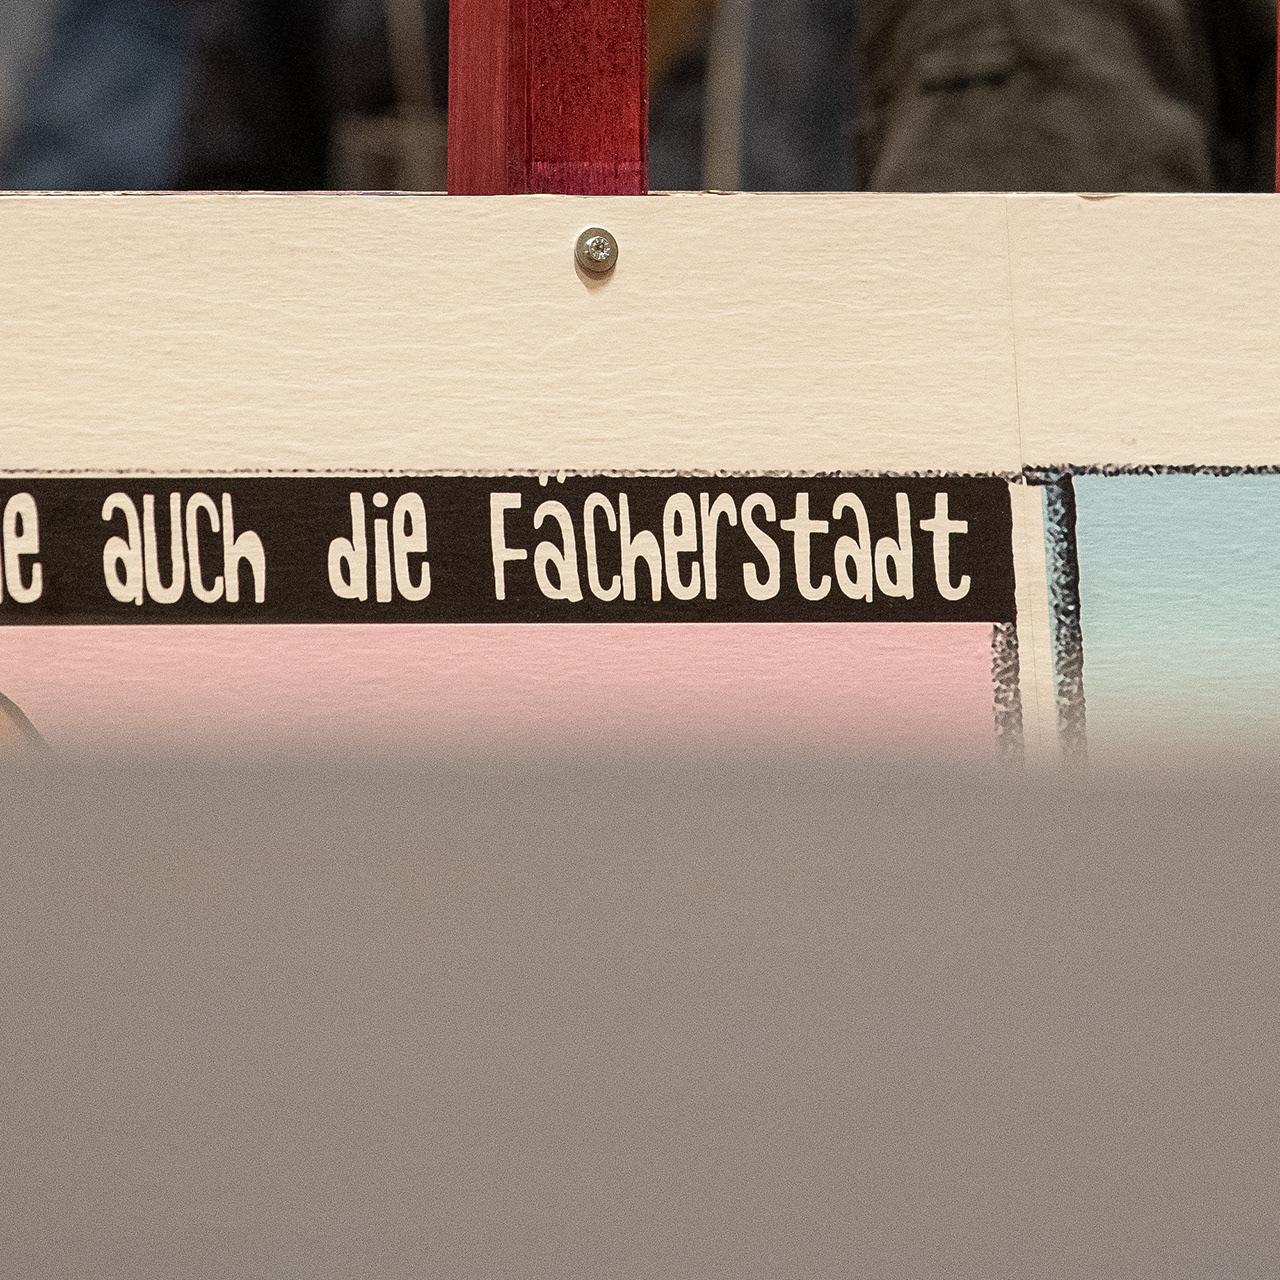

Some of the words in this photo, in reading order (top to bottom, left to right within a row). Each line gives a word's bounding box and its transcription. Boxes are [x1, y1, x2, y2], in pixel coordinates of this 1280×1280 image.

[101, 491, 266, 605] auch
[327, 491, 432, 603] die
[489, 472, 971, 602] Fächerstadt
